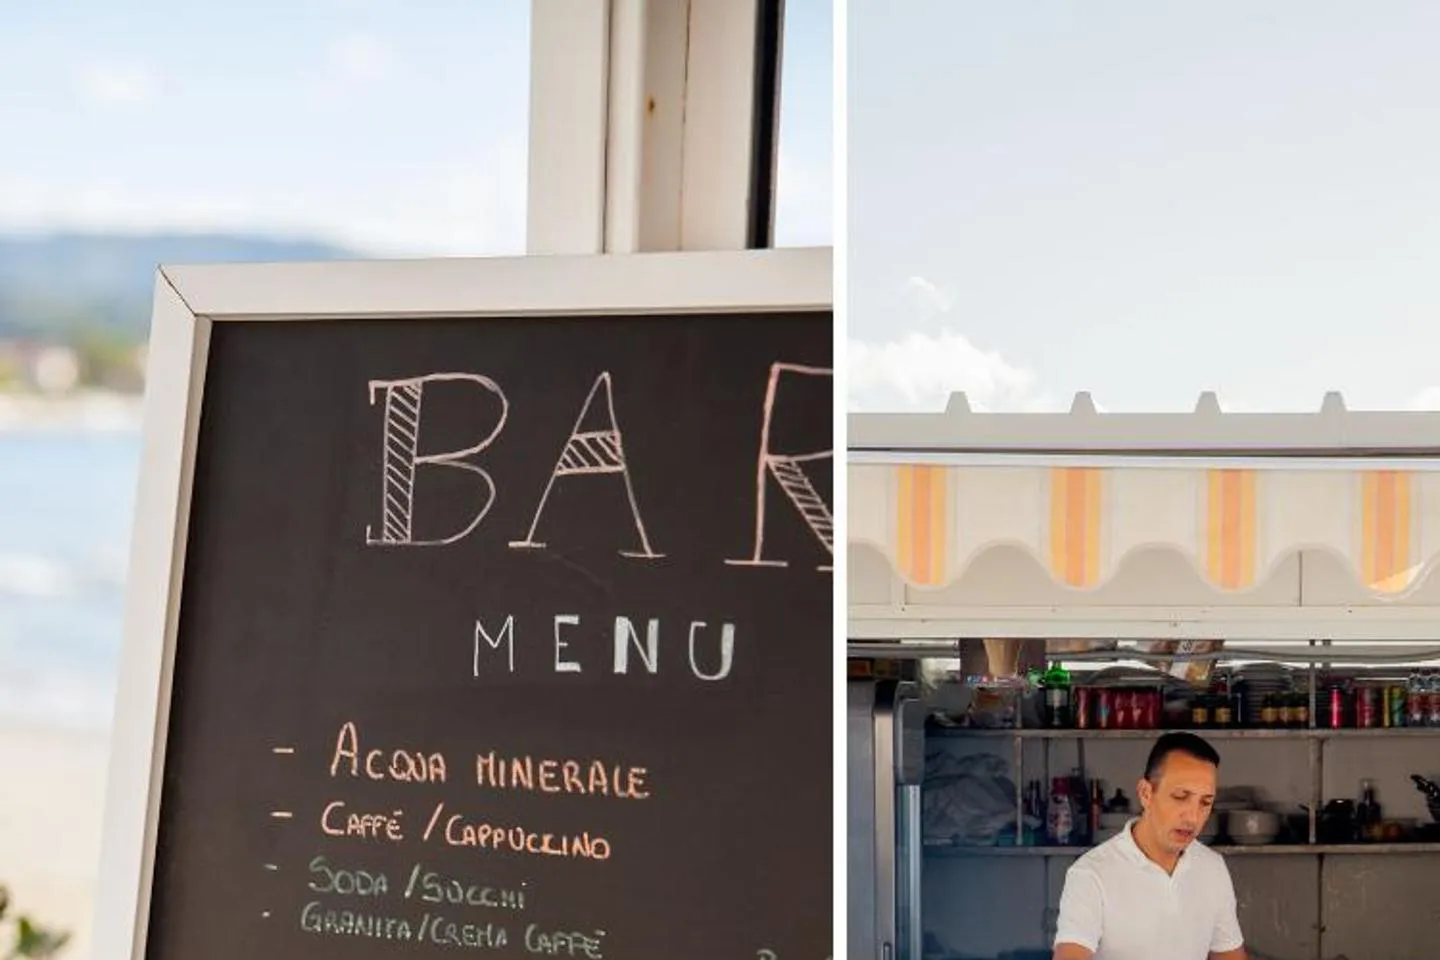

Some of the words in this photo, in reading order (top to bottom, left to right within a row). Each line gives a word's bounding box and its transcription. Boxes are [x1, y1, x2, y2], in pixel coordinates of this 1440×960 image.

[366, 362, 833, 572] BAR
[473, 614, 735, 681] MENU
[476, 751, 651, 799] MINERALE
